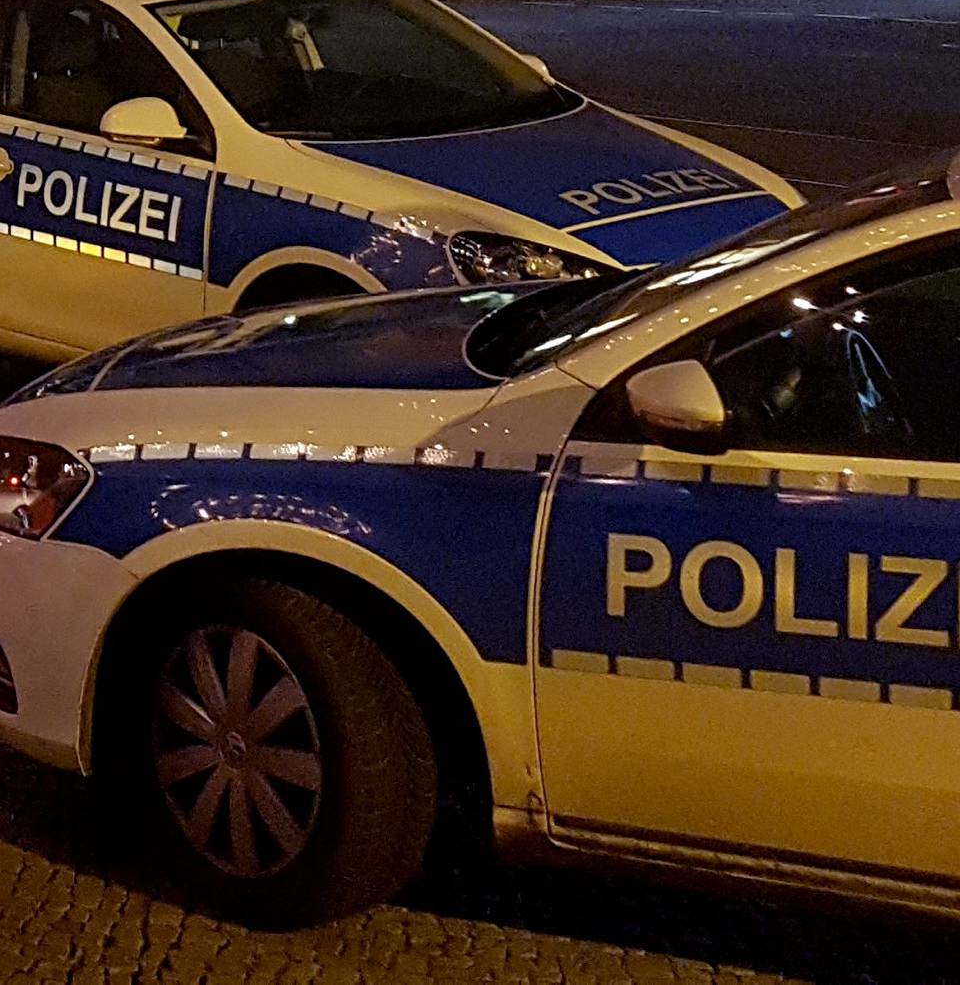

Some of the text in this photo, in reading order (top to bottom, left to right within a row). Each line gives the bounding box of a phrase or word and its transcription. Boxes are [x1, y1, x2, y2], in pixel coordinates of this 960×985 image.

[16, 163, 183, 243] POLIZEI
[558, 168, 739, 216] POLIZEI
[606, 532, 960, 648] POLIZ
